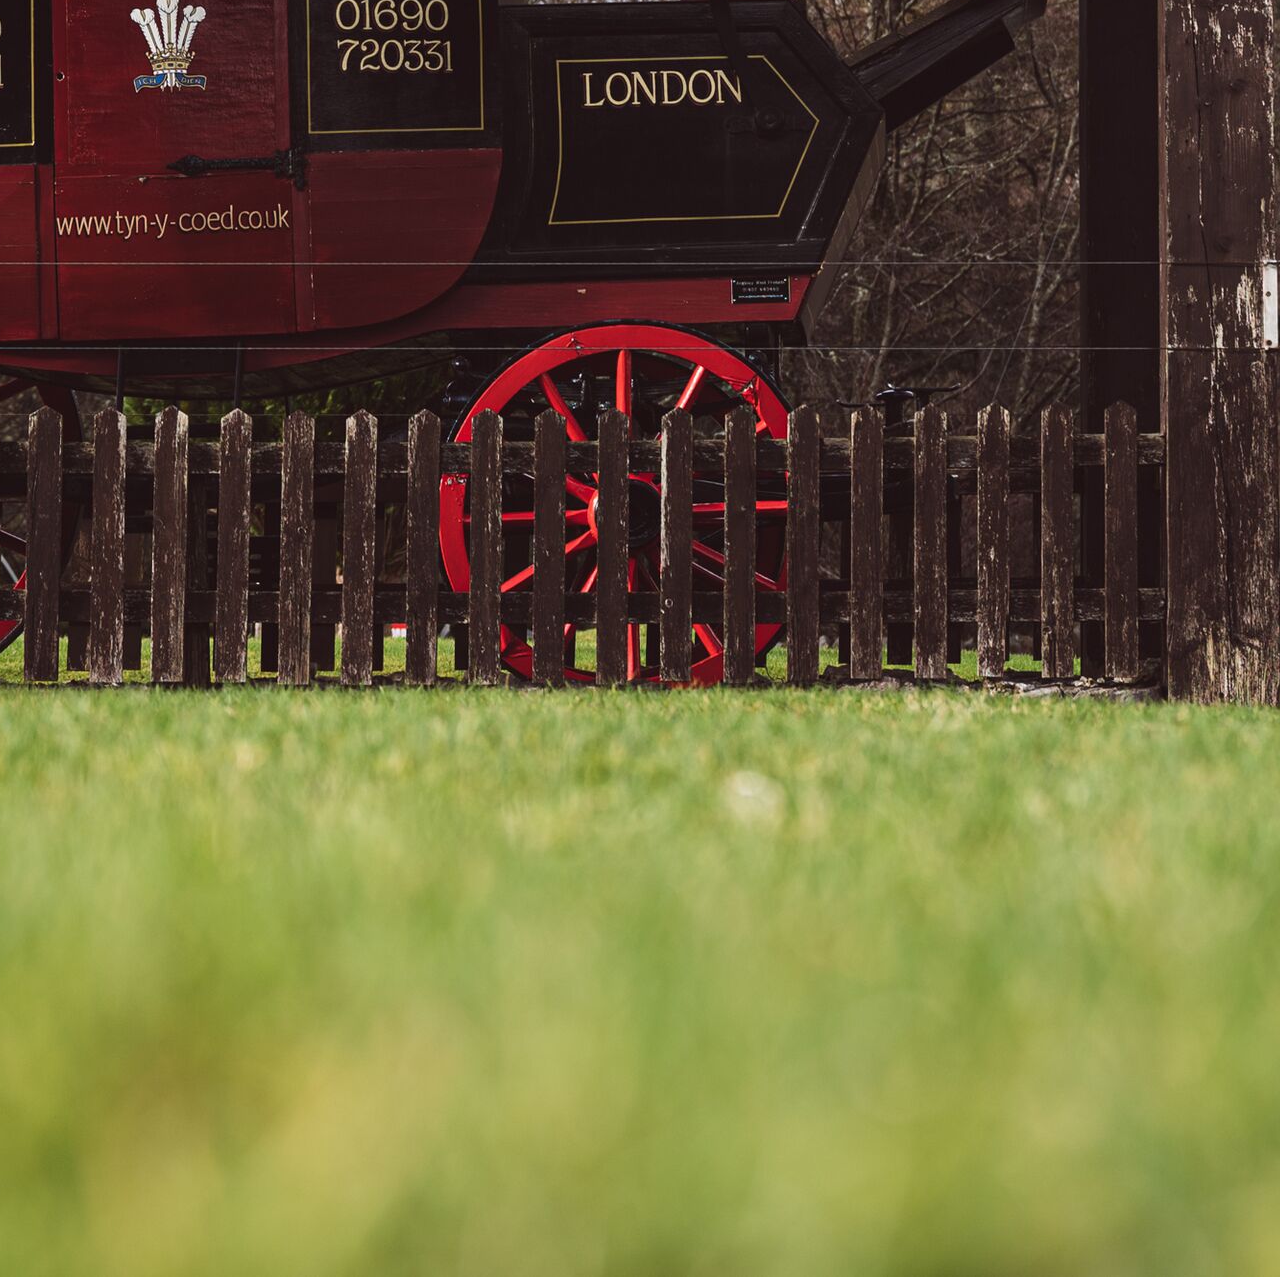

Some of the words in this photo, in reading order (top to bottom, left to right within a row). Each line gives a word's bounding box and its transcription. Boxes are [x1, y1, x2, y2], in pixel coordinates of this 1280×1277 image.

[336, 38, 453, 73] 720331
[582, 69, 743, 107] LONDON
[56, 203, 289, 240] www.tyn-y-coed.co.uk
